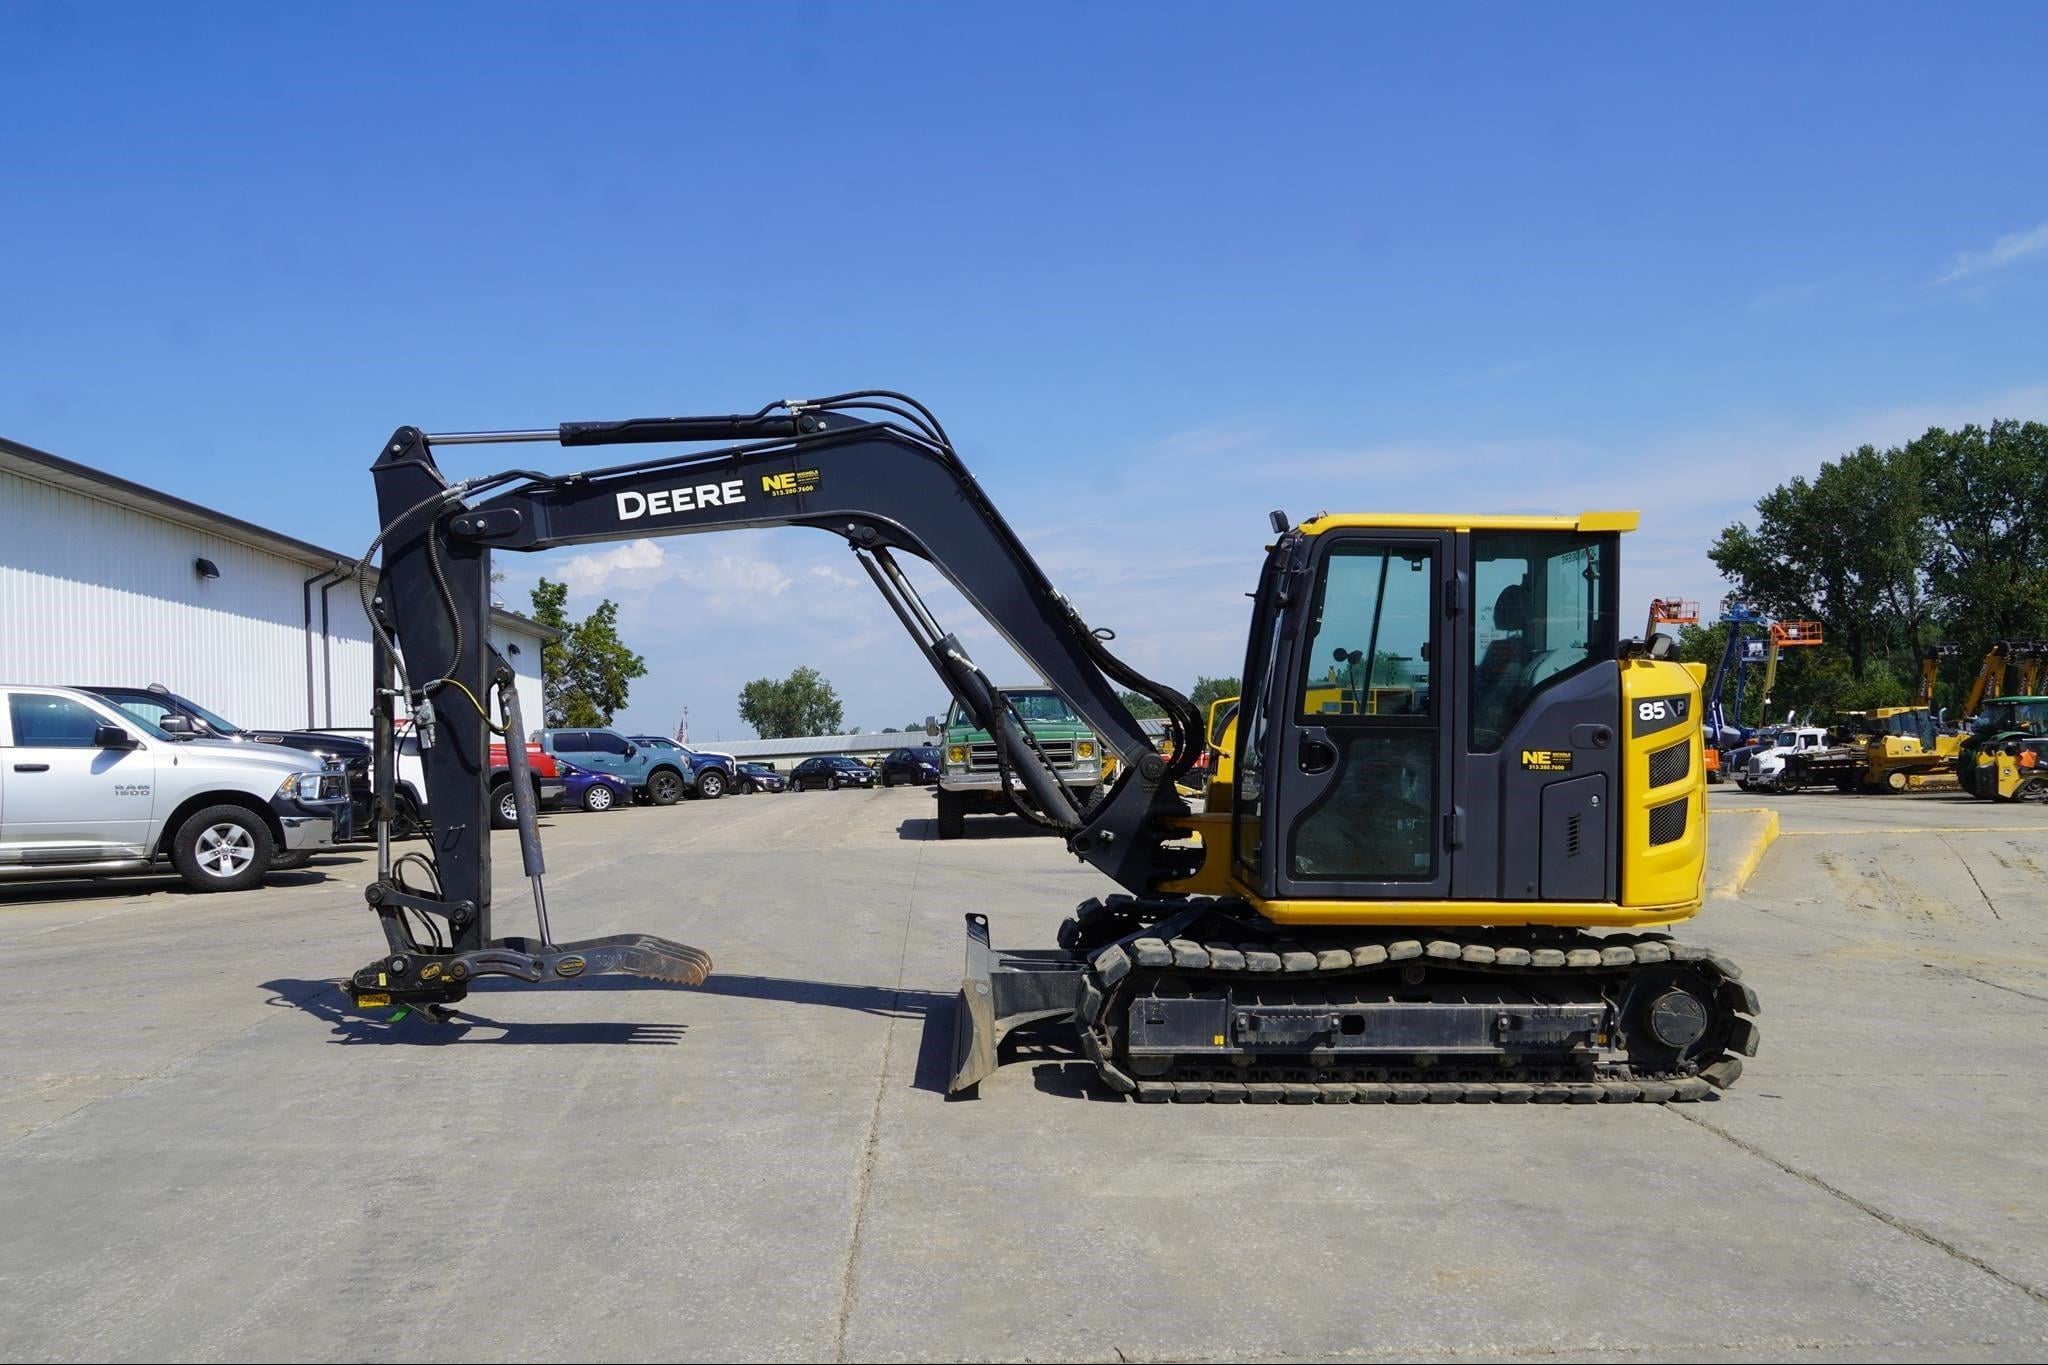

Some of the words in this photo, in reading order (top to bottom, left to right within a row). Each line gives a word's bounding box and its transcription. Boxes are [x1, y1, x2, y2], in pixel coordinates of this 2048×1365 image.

[762, 472, 797, 491] NE
[772, 485, 814, 497] 515.280.7600
[615, 479, 746, 520] DEERE
[1638, 701, 1666, 720] 85
[1677, 700, 1685, 715] P
[1522, 750, 1551, 764] NE
